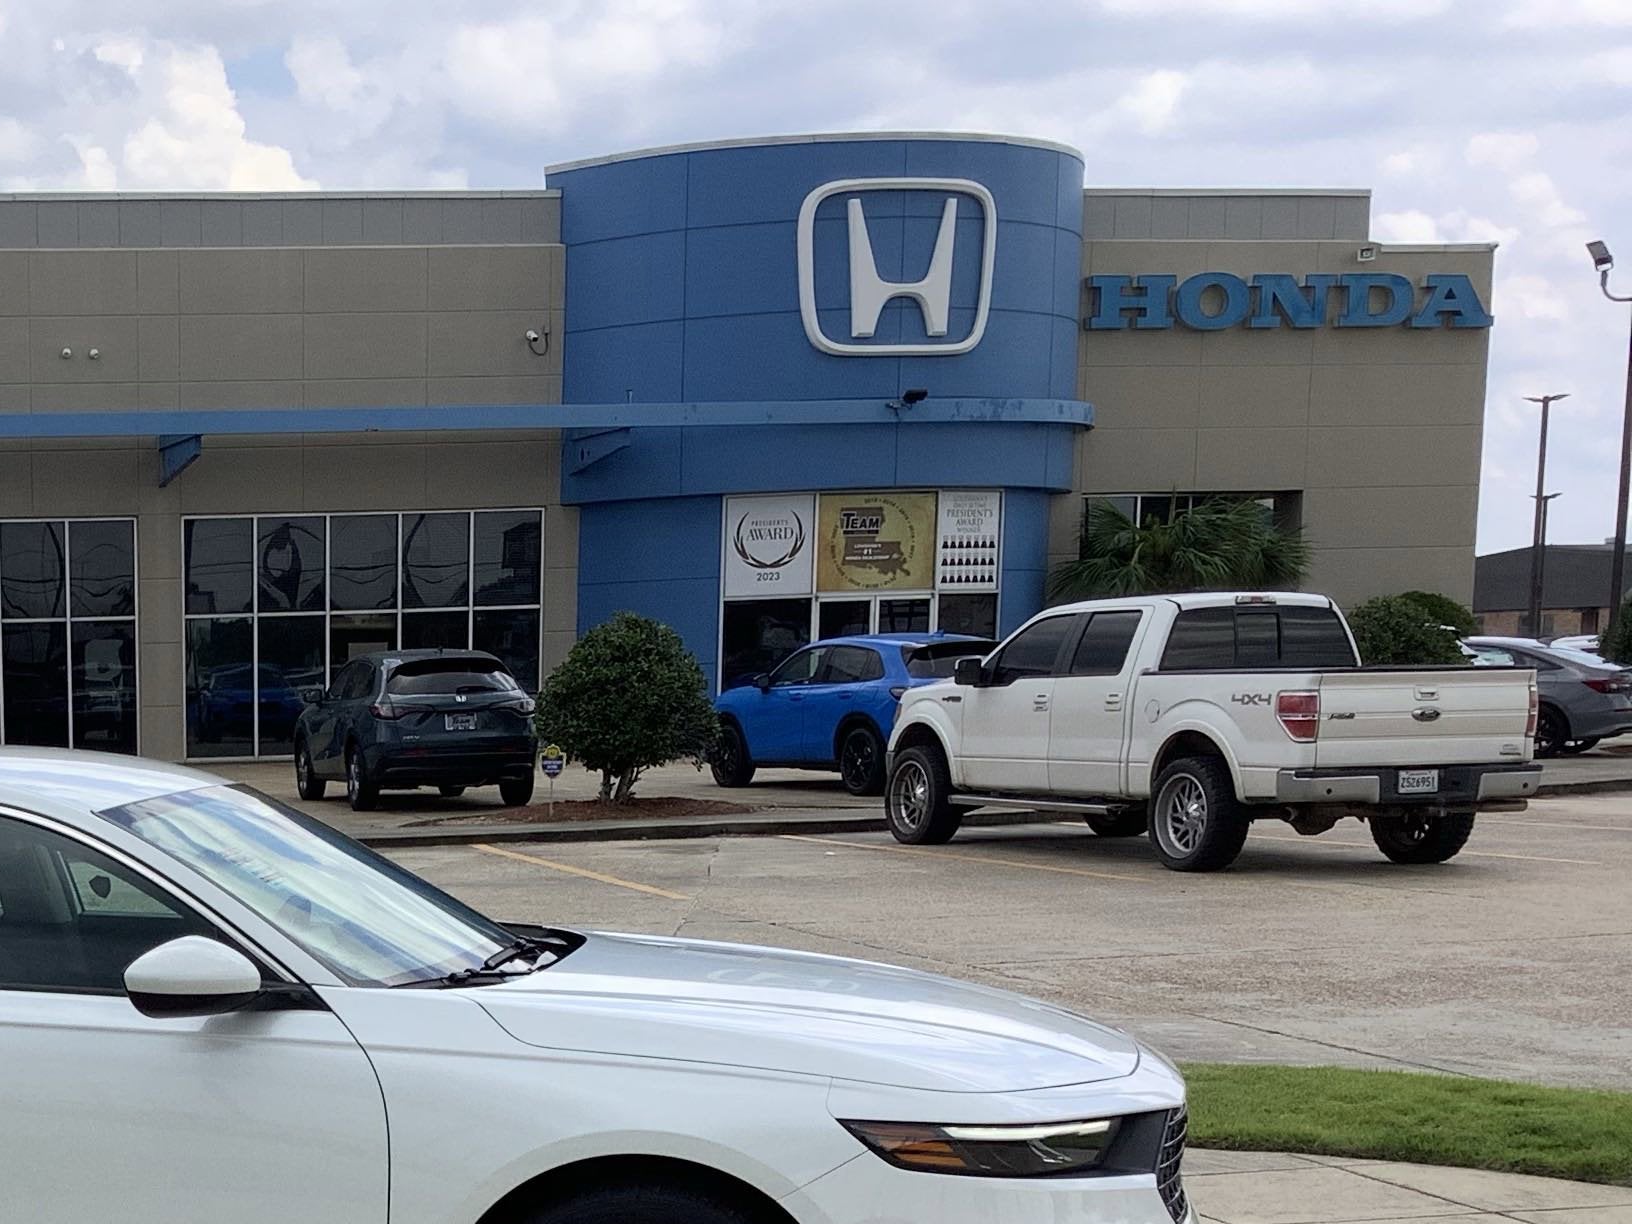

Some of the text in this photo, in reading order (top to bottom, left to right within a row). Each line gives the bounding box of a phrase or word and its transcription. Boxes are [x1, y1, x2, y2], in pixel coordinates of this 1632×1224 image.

[1086, 271, 1494, 331] HONDA
[841, 511, 880, 530] TEAM
[746, 526, 794, 541] AWARD
[756, 571, 780, 582] 2023
[1231, 693, 1273, 706] 4X4
